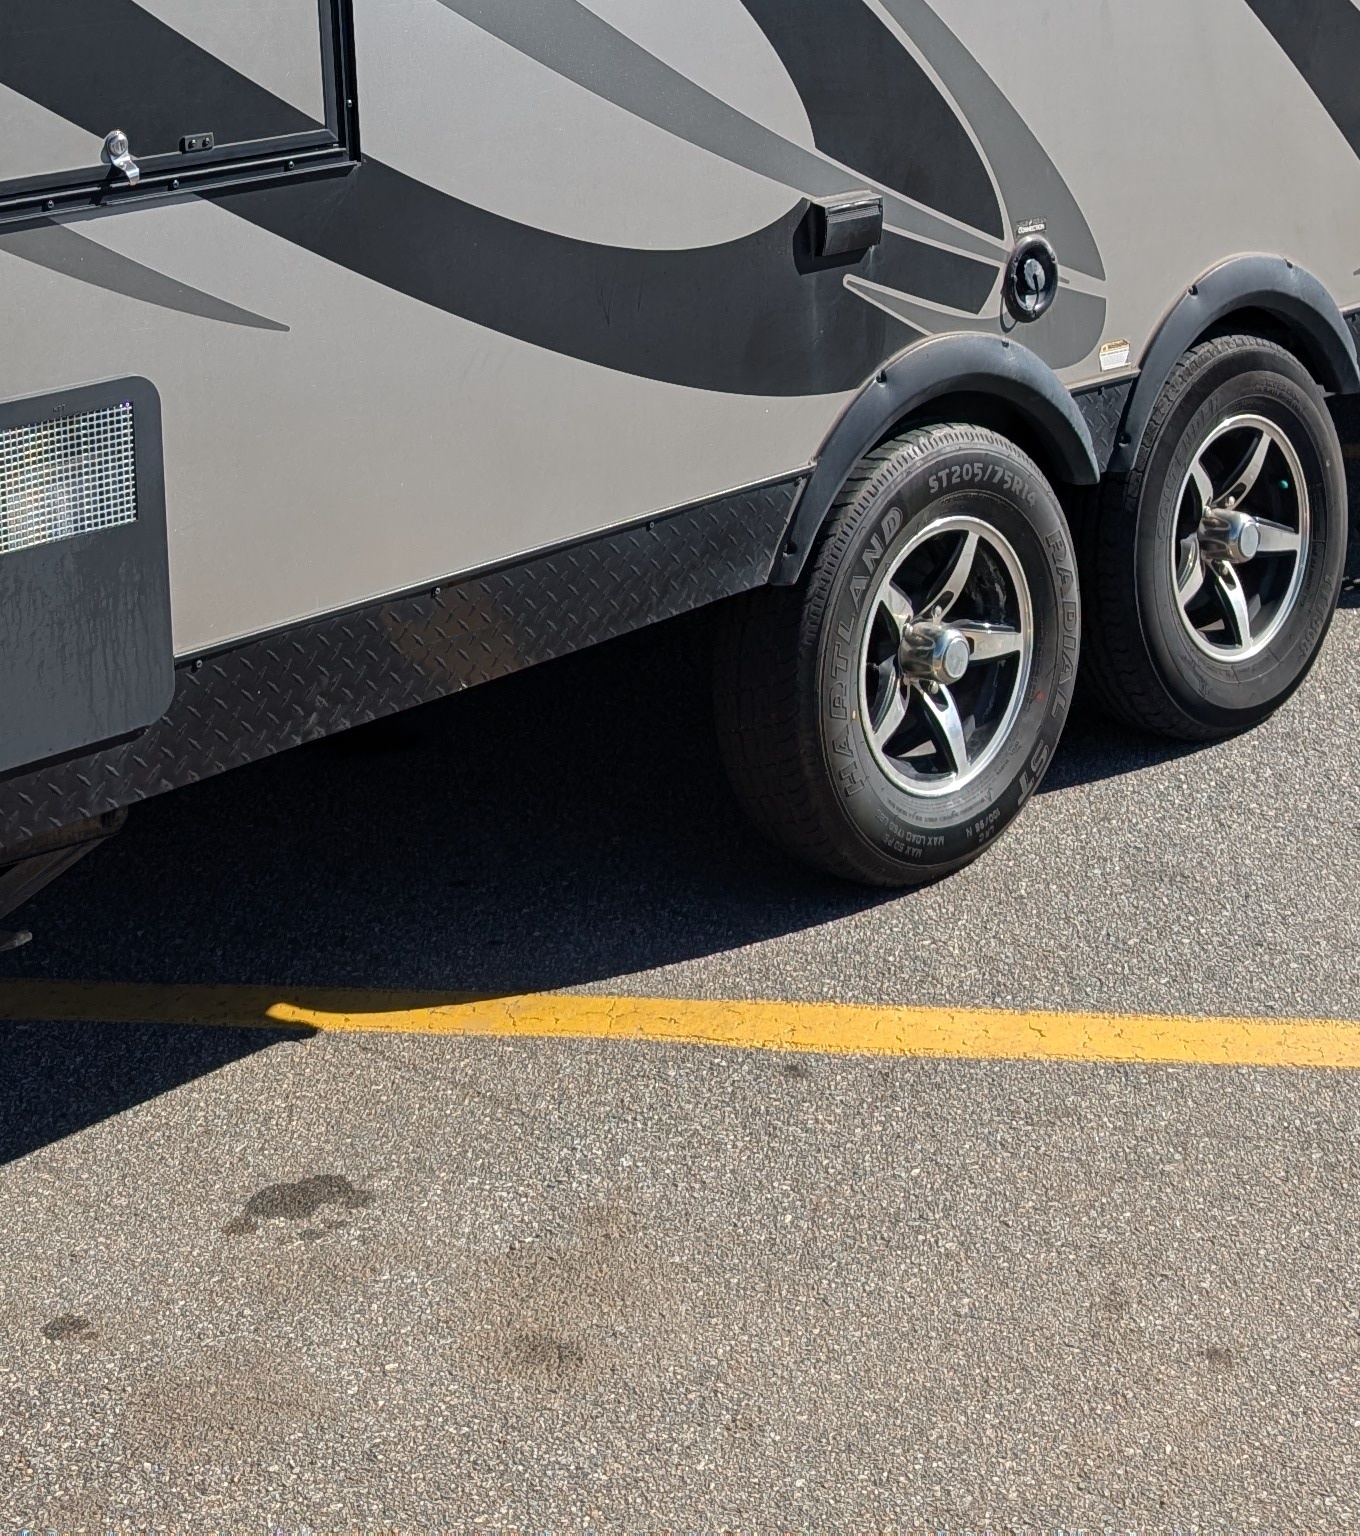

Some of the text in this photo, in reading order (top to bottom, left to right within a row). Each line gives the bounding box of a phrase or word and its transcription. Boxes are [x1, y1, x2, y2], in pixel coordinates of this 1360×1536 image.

[928, 462, 1038, 509] ST205/75R14
[1045, 529, 1077, 718] RADIAL
[828, 505, 904, 798] HARTLAND
[1016, 739, 1051, 808] ST
[905, 831, 926, 845] LOAD
[905, 845, 923, 858] MAX
[927, 835, 945, 847] MAX
